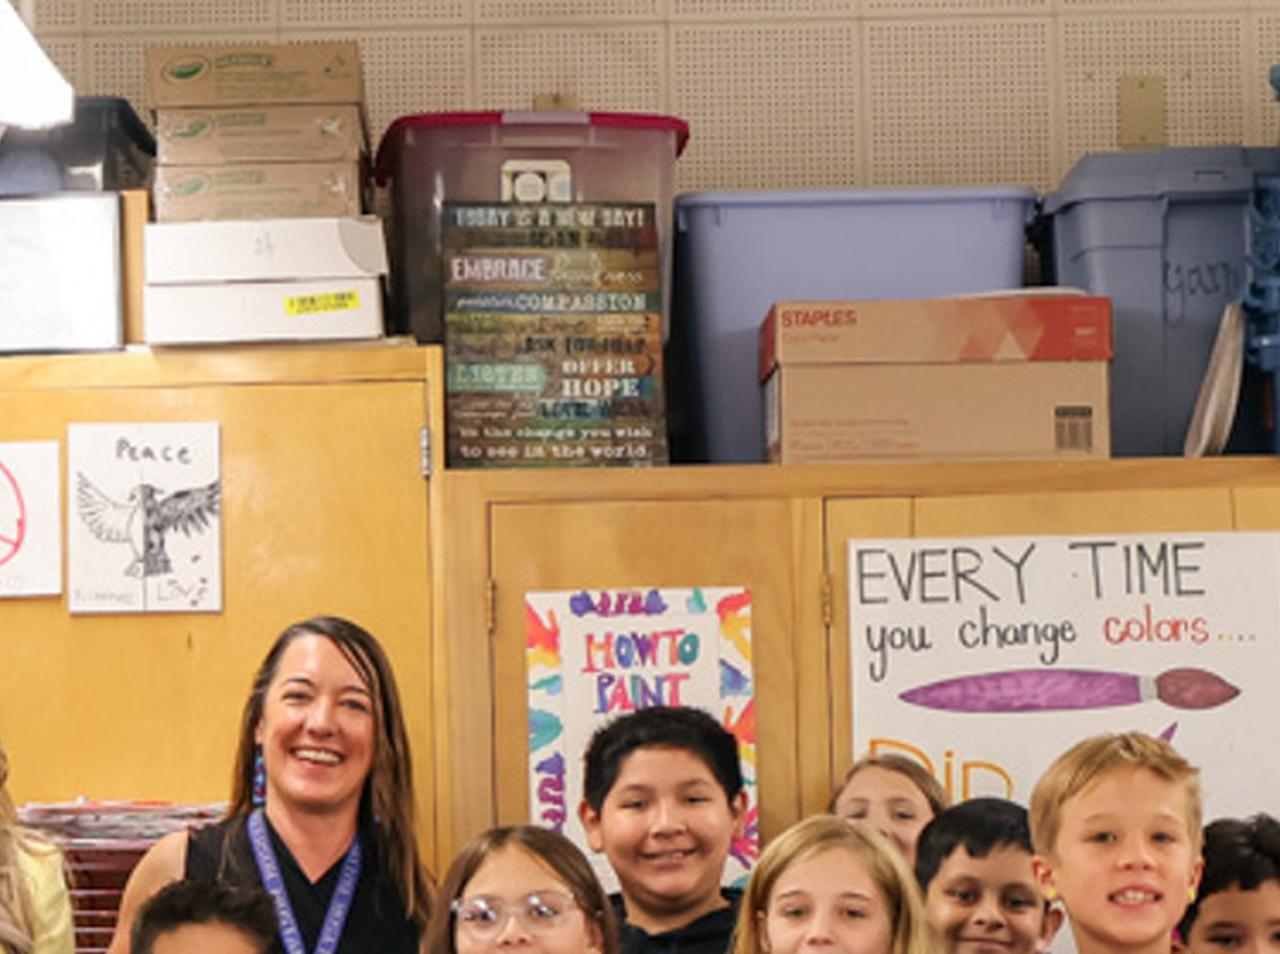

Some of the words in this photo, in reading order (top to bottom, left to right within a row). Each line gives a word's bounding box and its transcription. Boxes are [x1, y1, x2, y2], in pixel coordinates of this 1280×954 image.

[451, 257, 546, 282] EMBRACE
[518, 292, 648, 312] COMPASSION
[781, 309, 858, 328] STAPLES
[561, 377, 641, 397] HOPE
[114, 437, 192, 465] Peace
[856, 543, 1037, 606] EVERY
[1068, 541, 1207, 600] TIME
[581, 630, 660, 674] HOW
[659, 627, 700, 666] TO
[865, 622, 933, 682] you
[957, 605, 1077, 666] change
[593, 672, 691, 714] PAINT
